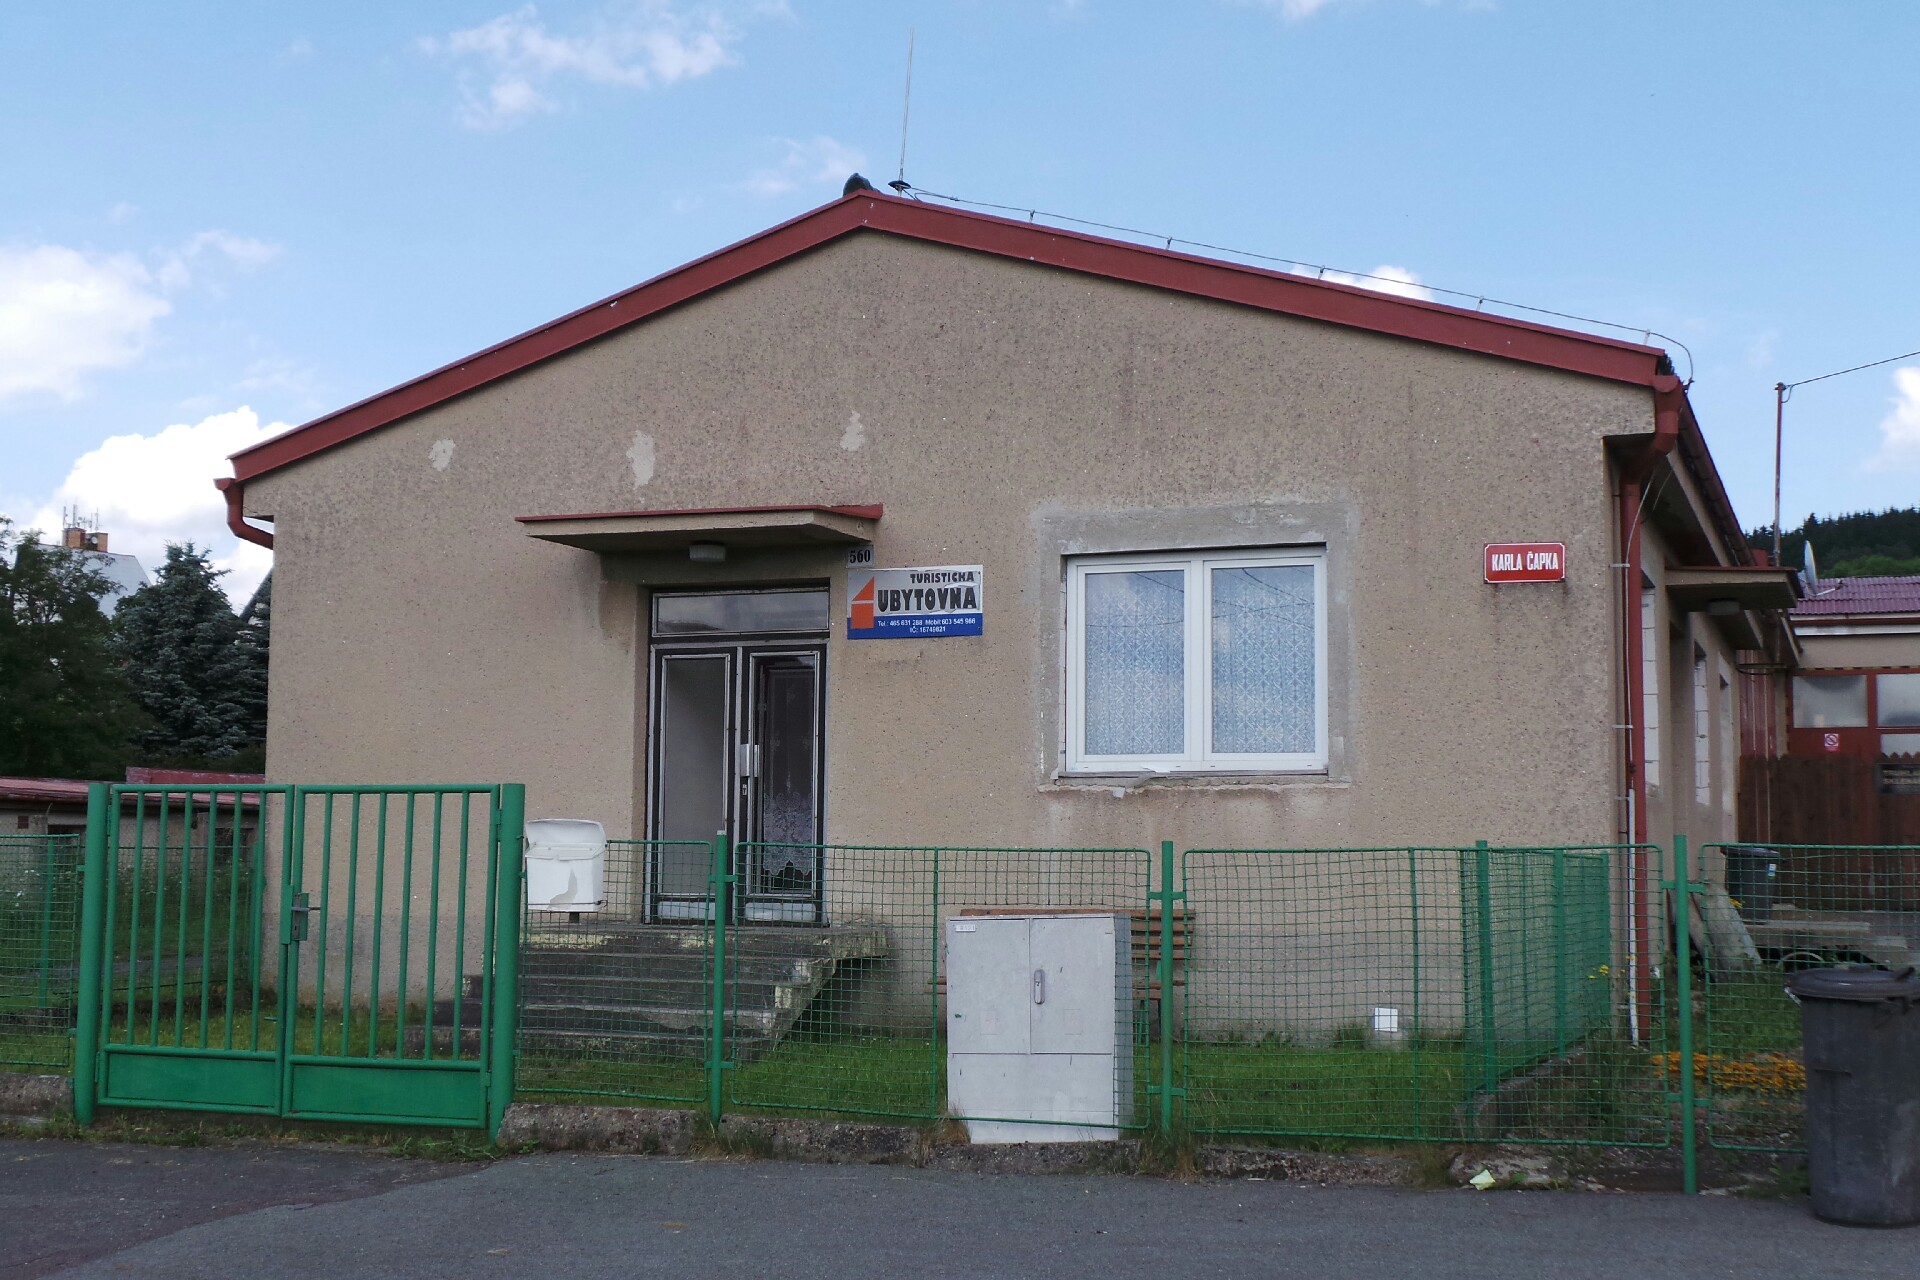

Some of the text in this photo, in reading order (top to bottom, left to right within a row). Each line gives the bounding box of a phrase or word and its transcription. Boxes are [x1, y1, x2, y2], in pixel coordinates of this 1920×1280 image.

[850, 550, 871, 563] 560
[1491, 551, 1559, 571] KARLA ČAPKA
[877, 587, 977, 612] UBYTOVNA
